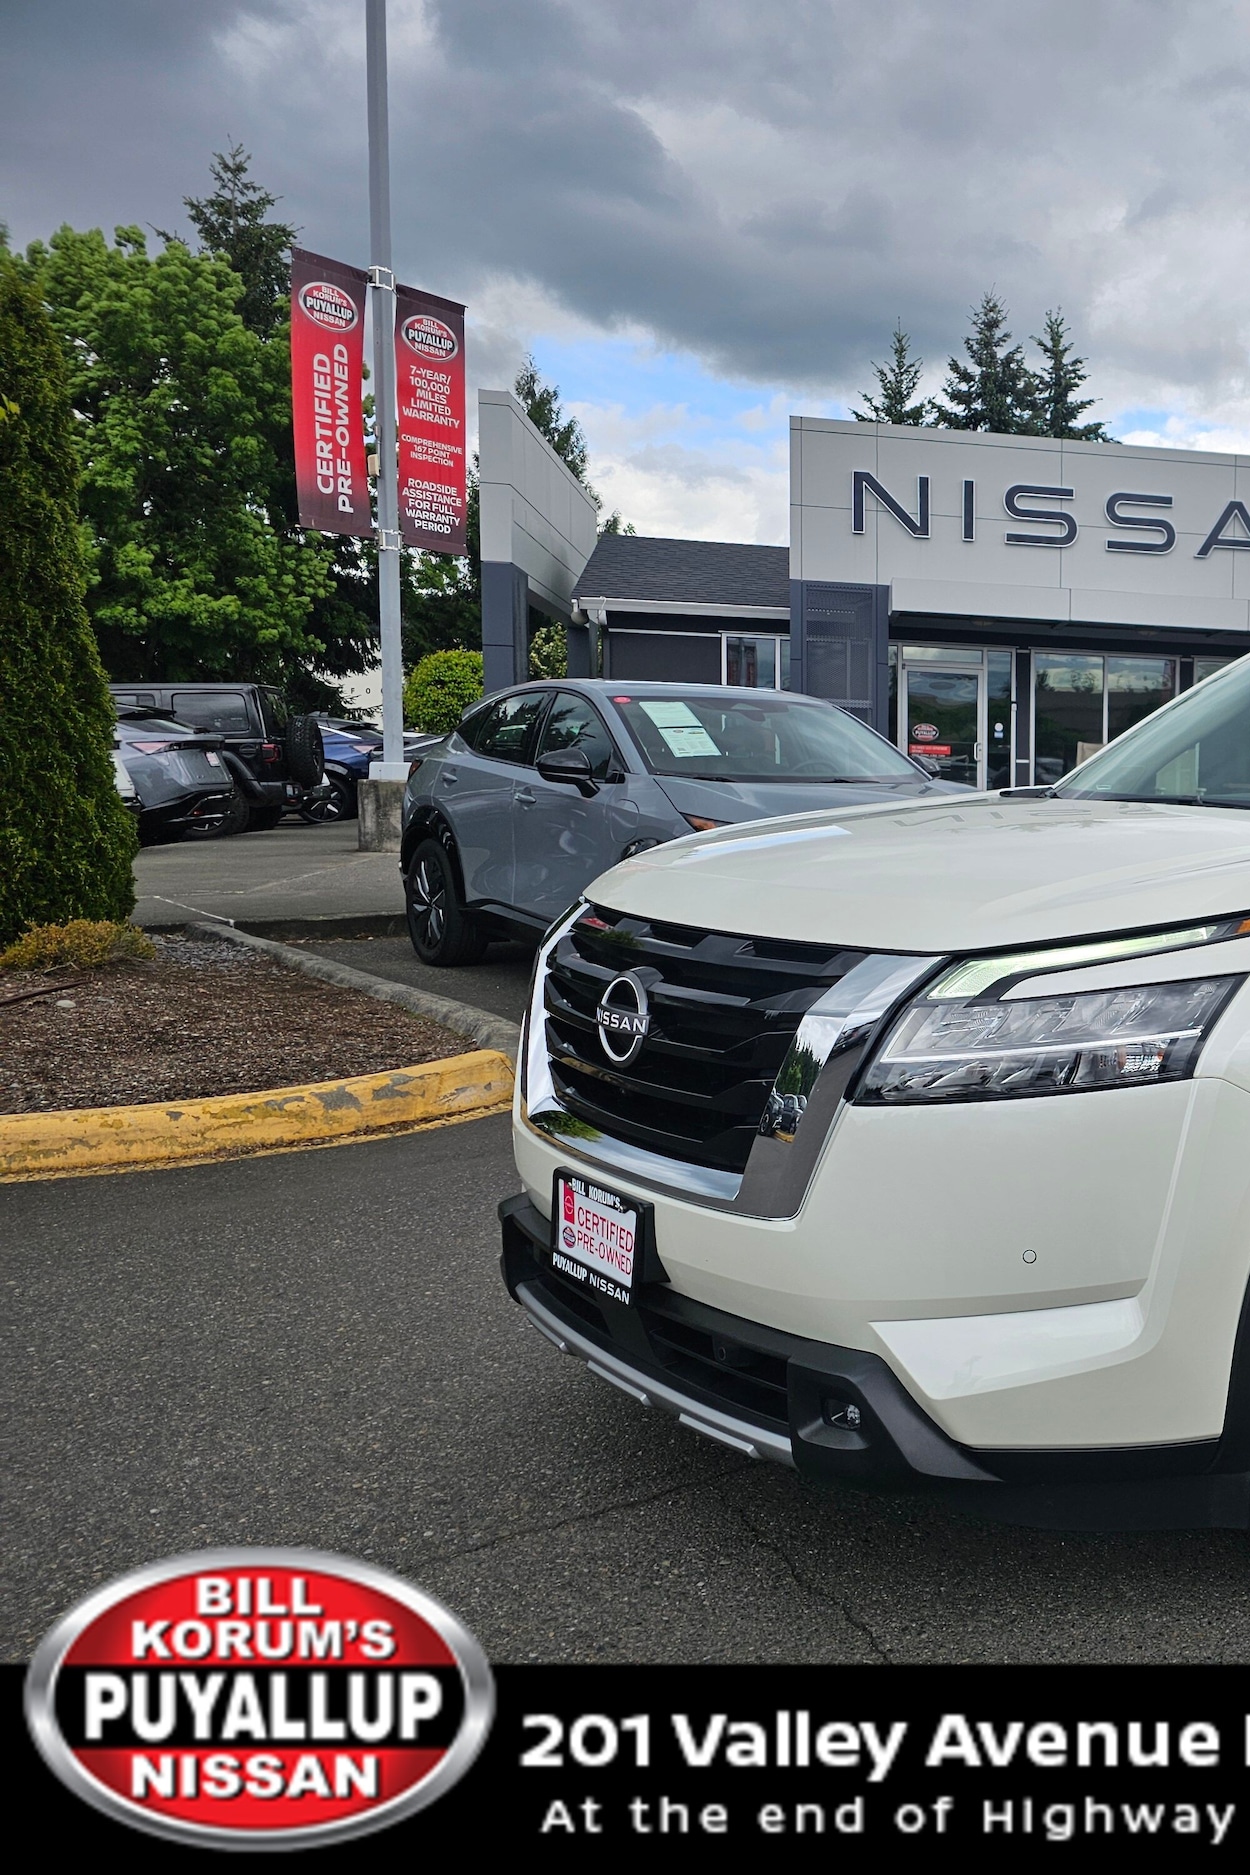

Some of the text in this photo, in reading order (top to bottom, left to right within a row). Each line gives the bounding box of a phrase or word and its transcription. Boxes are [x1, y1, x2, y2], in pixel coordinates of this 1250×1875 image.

[312, 289, 347, 307] KORUM'S
[321, 285, 339, 297] BILL
[306, 296, 353, 321] PUYALLUP
[313, 310, 346, 328] NISSAN
[422, 319, 439, 329] BILL
[408, 328, 453, 350] PUYALLUP
[414, 322, 448, 337] KORUM'S
[414, 342, 446, 357] NISSAN
[410, 365, 451, 385] 7-YEAR/
[409, 376, 450, 395] 100,000
[416, 388, 447, 405] MILES
[411, 397, 452, 416] LIMITED
[313, 353, 335, 494] CERTIFIED
[402, 406, 460, 429] WARRANTY
[333, 343, 354, 513] PRE-OWNED
[401, 434, 462, 455] COMPREHENSIVE
[428, 447, 450, 459] POINT
[410, 451, 454, 467] INSPECTION
[407, 477, 457, 496] ROADSIDE
[402, 487, 462, 507] ASSISTANCE
[408, 498, 455, 516] FOR FULL
[405, 507, 460, 527] WARRANTY
[414, 519, 452, 534] PERIOD
[596, 1006, 647, 1034] NISSAN
[571, 1177, 621, 1208] BILL KORUM'S
[577, 1206, 634, 1253] CERTIFIED
[577, 1230, 632, 1276] PRE-OWNED
[552, 1252, 630, 1305] PUYALLUP NISSAN
